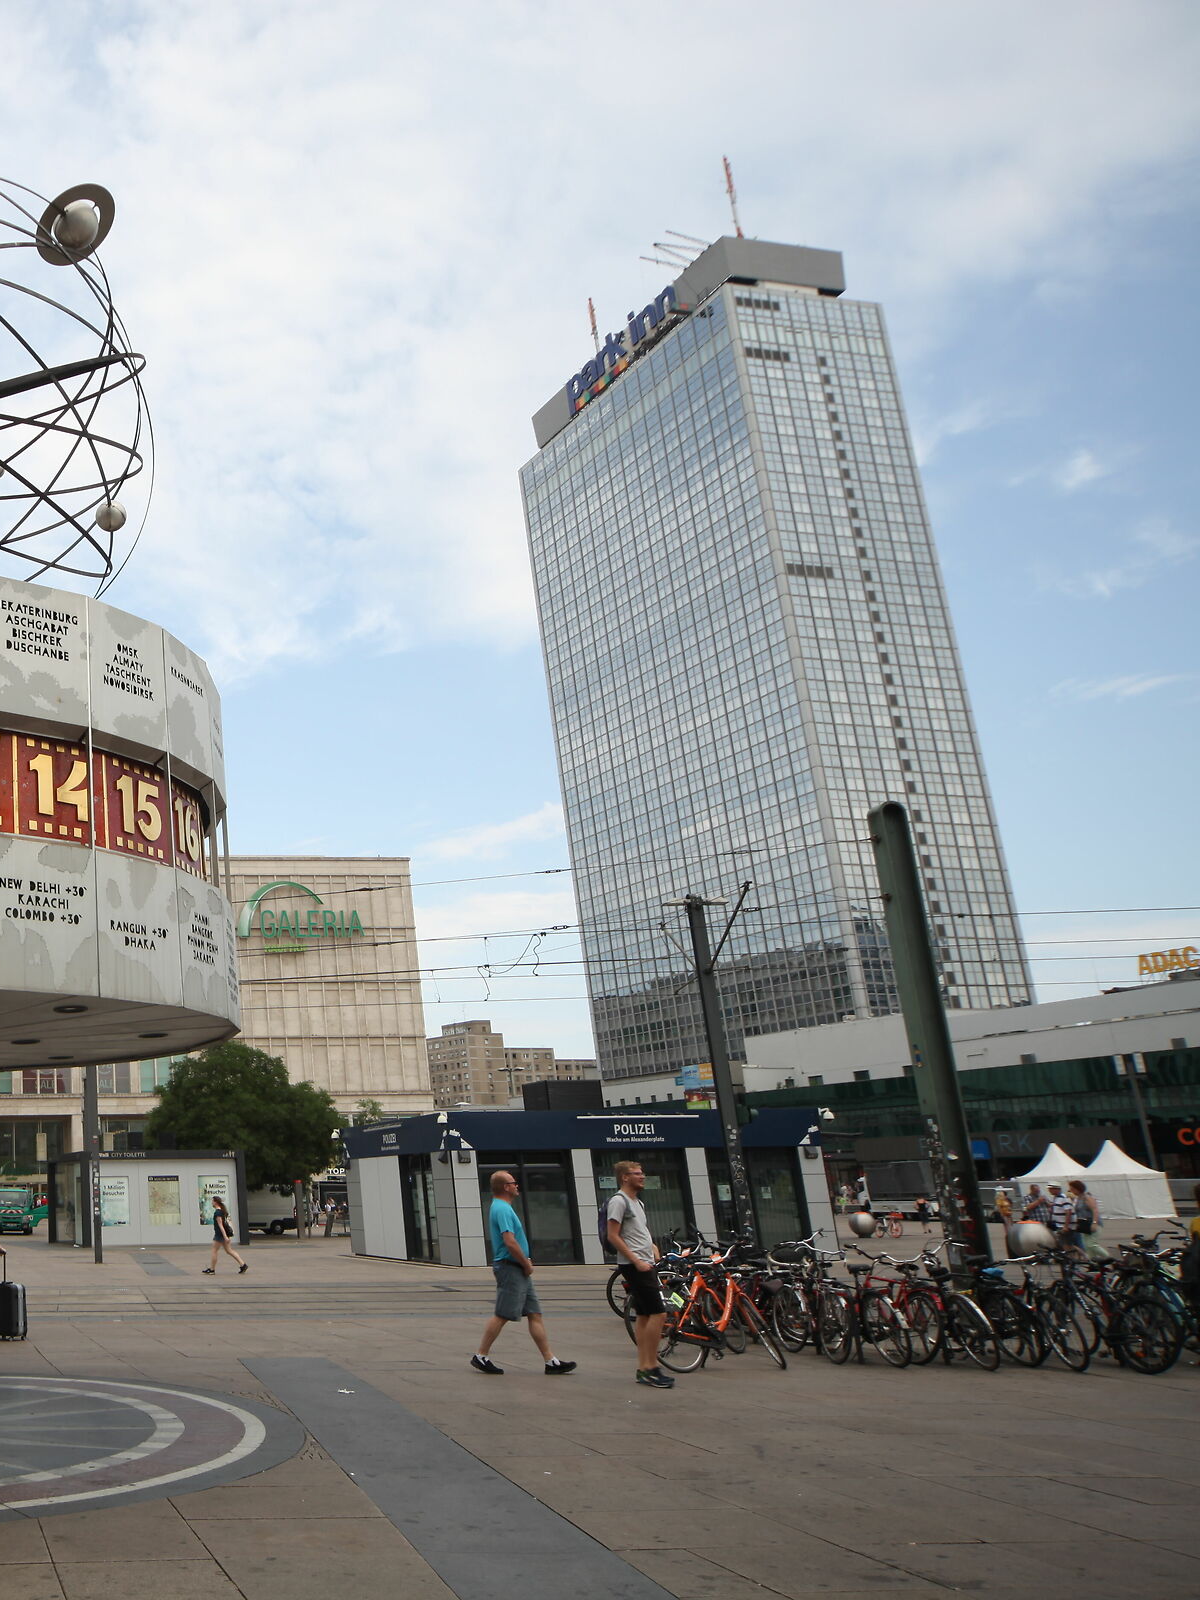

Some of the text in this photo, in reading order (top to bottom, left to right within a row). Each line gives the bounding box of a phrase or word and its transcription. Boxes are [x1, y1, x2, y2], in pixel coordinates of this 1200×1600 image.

[566, 333, 627, 417] park
[628, 285, 676, 346] inn
[6, 614, 68, 636] ASCHGABAT
[12, 628, 62, 648] BISCHKEK
[6, 640, 70, 661] DUSCHANBE
[117, 643, 139, 659] OMSK
[113, 654, 144, 672] ALMATY
[106, 663, 150, 688] TASCHKENT
[103, 675, 154, 701] NOWOSIBIRSK
[30, 754, 89, 822] 14
[116, 774, 162, 842] 15
[175, 796, 199, 863] 16
[0, 877, 22, 890] NEW
[30, 880, 60, 894] DELHI
[18, 894, 69, 910] KARACHI
[5, 908, 54, 922] COLOMBO
[194, 912, 210, 926] HANOI
[260, 910, 366, 938] GALERIA
[110, 920, 147, 936] RANGUN
[124, 936, 156, 950] DHAKA
[194, 950, 216, 966] JAKARTA
[1138, 946, 1200, 976] ADAC
[614, 1124, 654, 1134] POLIZEI
